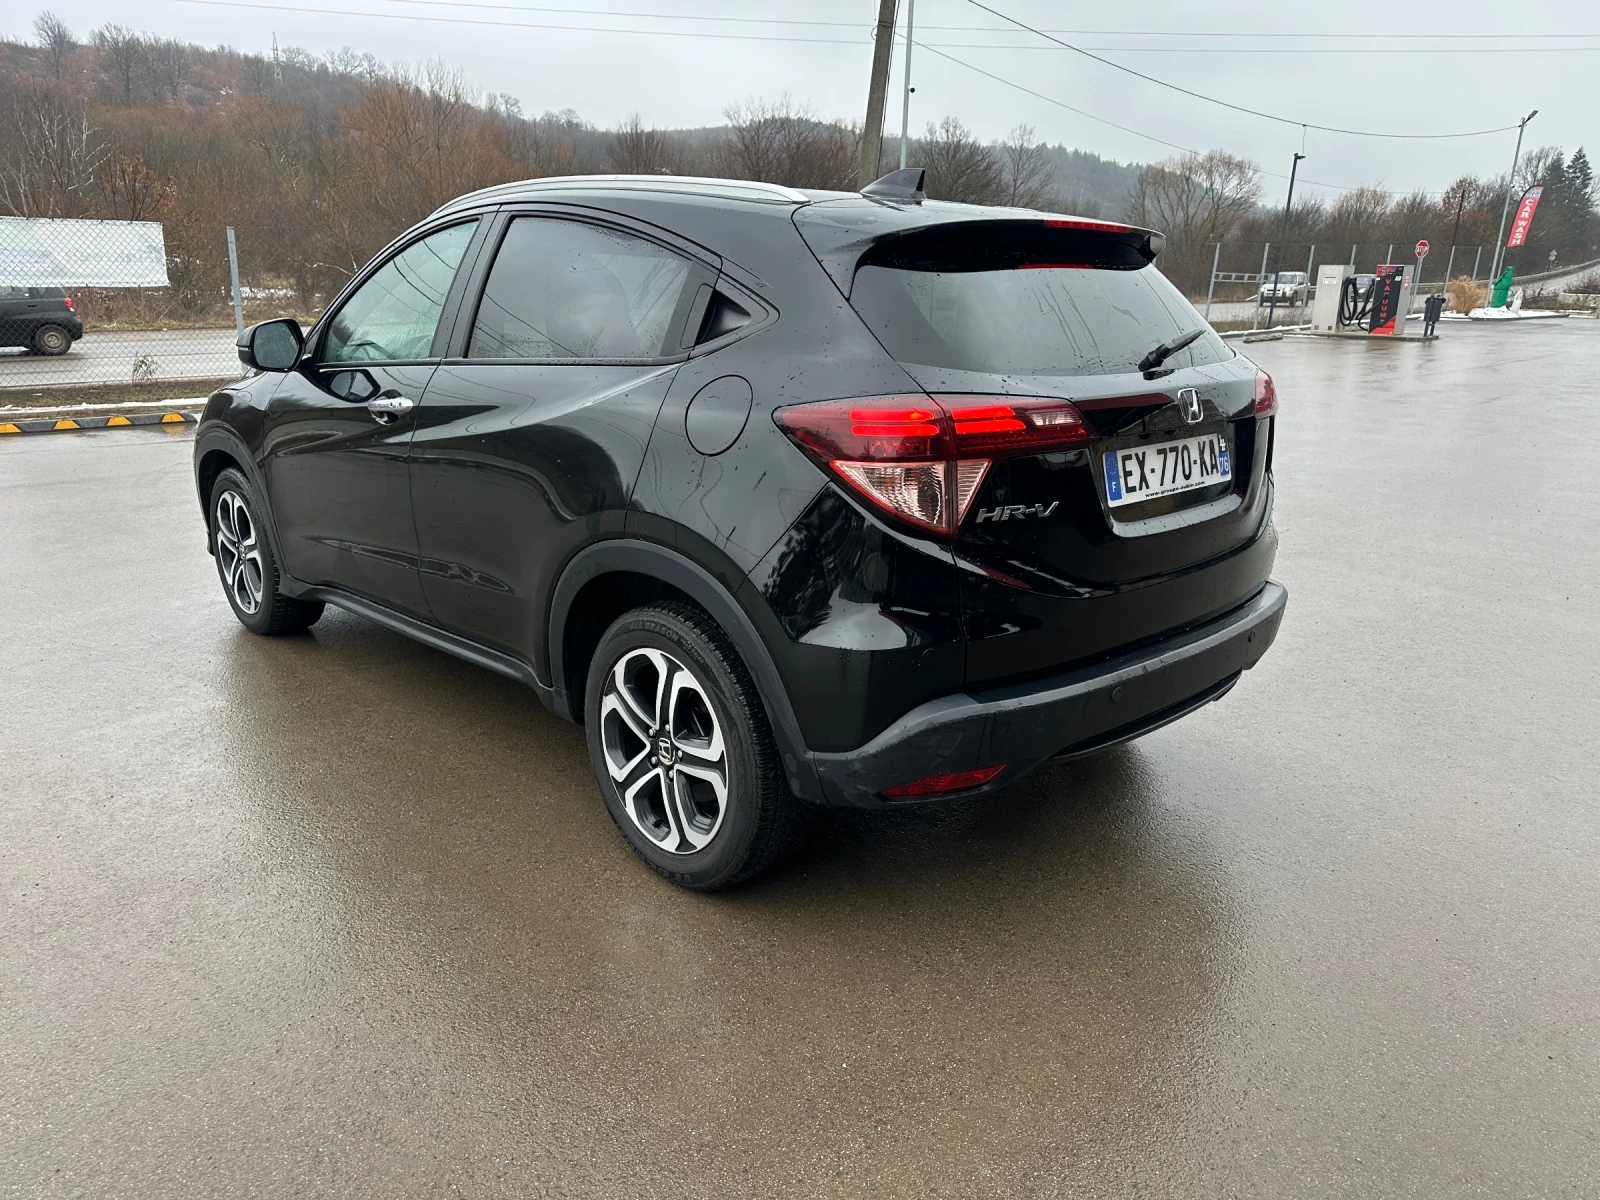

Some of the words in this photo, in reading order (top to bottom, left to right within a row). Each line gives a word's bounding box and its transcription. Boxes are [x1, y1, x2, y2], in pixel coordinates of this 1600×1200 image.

[1521, 199, 1535, 218] CAR
[1511, 220, 1528, 245] WASH
[1121, 439, 1219, 494] EX-770-KA
[1219, 456, 1229, 473] 76
[1112, 481, 1117, 493] F
[975, 501, 1060, 523] HR-V
[644, 621, 680, 642] SEASON
